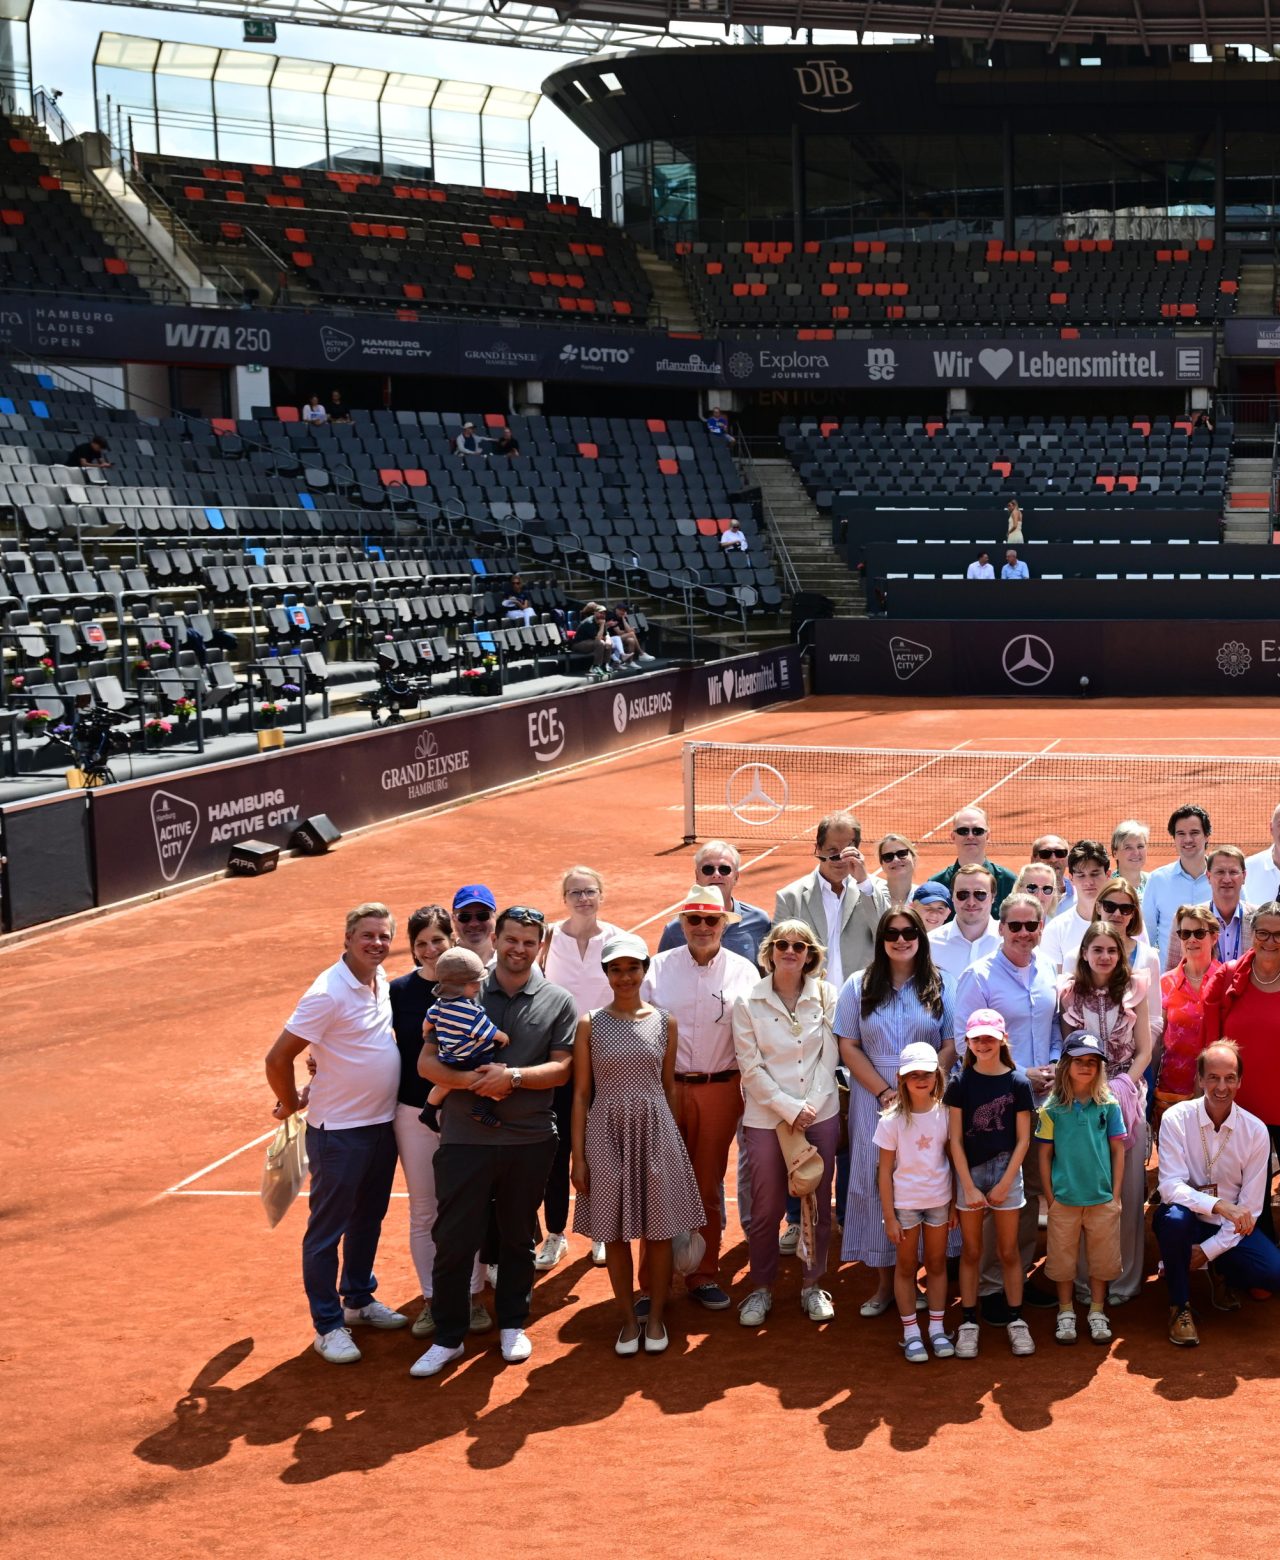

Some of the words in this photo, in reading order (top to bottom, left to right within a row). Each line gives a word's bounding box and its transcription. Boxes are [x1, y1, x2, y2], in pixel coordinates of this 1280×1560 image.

[794, 60, 853, 97] DTB
[36, 309, 114, 322] HAMBURG
[37, 322, 94, 335] LADIES
[165, 323, 231, 349] WTA
[235, 327, 271, 352] 250
[39, 336, 80, 347] OPEN
[361, 338, 420, 349] HAMBURG
[362, 347, 403, 357] ACTIVE
[406, 349, 432, 357] CITY
[465, 350, 499, 360] GRAND
[760, 351, 829, 371] Explora
[933, 351, 973, 377] Wir
[1019, 350, 1164, 377] Lebensmittel.
[829, 653, 849, 662] WTA
[896, 653, 924, 661] ACTIVE
[708, 674, 722, 706] Wir
[734, 662, 778, 699] Lebensmittel.
[629, 690, 673, 721] ASKLEPIOS
[528, 707, 560, 748] ECE
[381, 761, 426, 790] GRAND
[427, 750, 470, 777] ELYSEE
[408, 776, 448, 799] HAMBURG
[208, 788, 285, 822] HAMBURG
[160, 821, 192, 842] ACTIVE
[210, 814, 265, 843] ACTIVE
[267, 804, 300, 828] CITY
[162, 840, 183, 859] CITY
